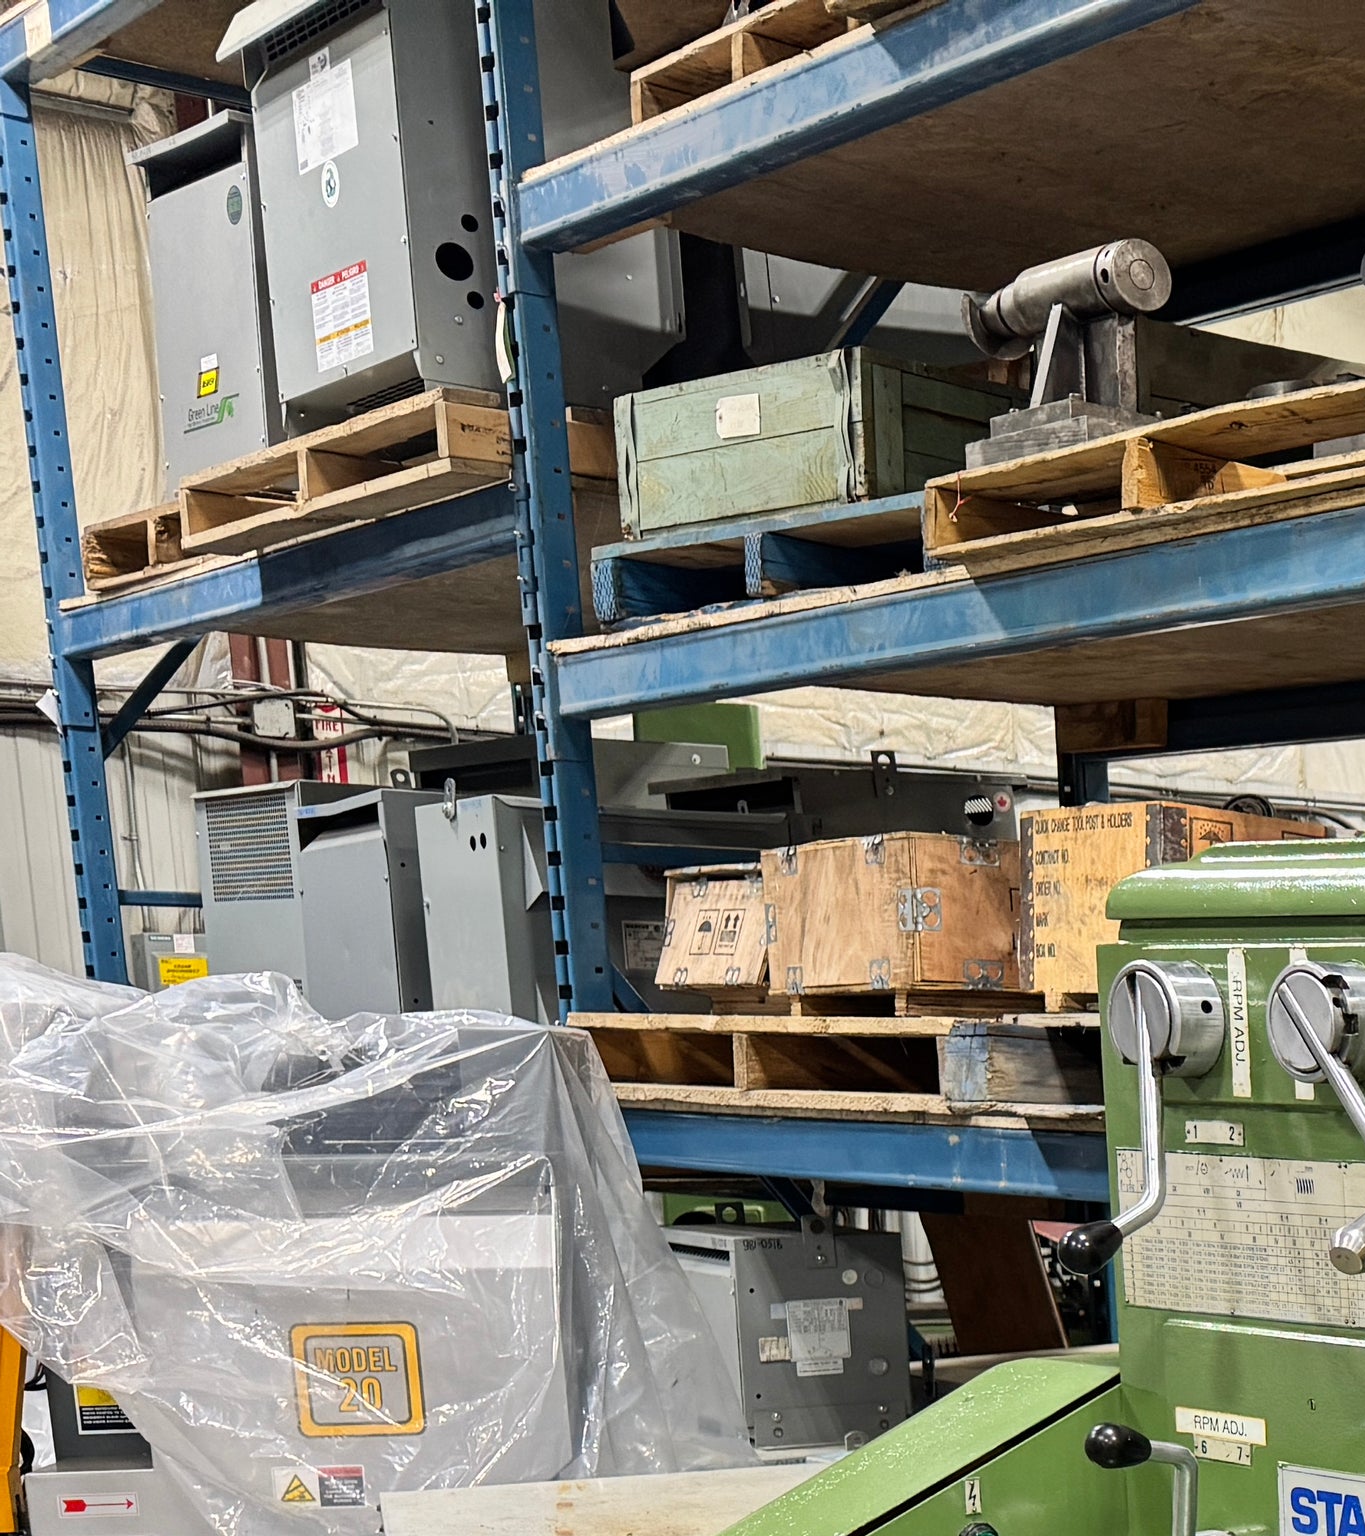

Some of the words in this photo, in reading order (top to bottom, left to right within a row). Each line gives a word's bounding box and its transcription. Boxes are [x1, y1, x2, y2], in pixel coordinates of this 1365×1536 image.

[318, 275, 335, 289] DANGER
[187, 407, 206, 422] Green
[206, 403, 220, 417] Line
[1035, 818, 1050, 835] QUICK
[1051, 816, 1070, 833] CHANGE
[1072, 815, 1085, 832] TOOL
[1085, 814, 1099, 831] POST
[1107, 811, 1133, 829] HOLDERS
[1231, 979, 1243, 1021] RPM
[1234, 1026, 1246, 1067] ADJ.
[1193, 1126, 1198, 1140] 1
[1229, 1126, 1235, 1141] 2
[314, 1346, 398, 1373] MODEL
[338, 1377, 383, 1413] 20
[1193, 1414, 1219, 1433] RPM
[1222, 1419, 1247, 1437] ADJ.
[1201, 1440, 1208, 1454] 6
[1237, 1446, 1243, 1461] 7
